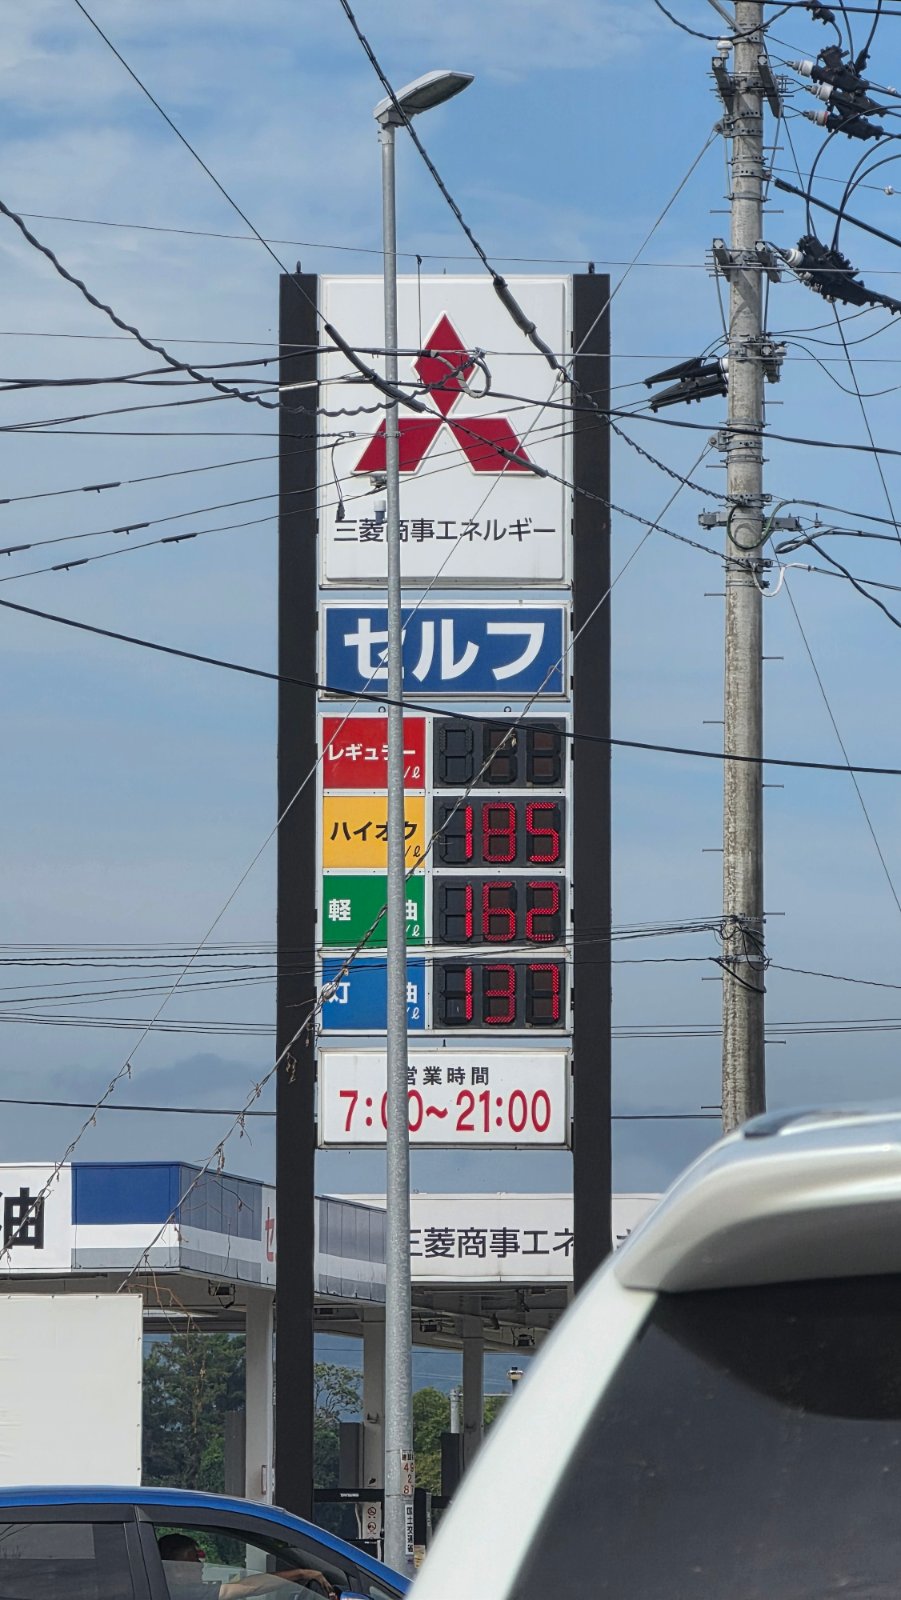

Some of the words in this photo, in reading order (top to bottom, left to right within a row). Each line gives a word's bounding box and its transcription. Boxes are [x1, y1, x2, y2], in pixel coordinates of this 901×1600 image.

[344, 618, 545, 682] セルフ
[465, 802, 560, 862] 185
[465, 881, 560, 941] 162
[465, 963, 560, 1023] 137
